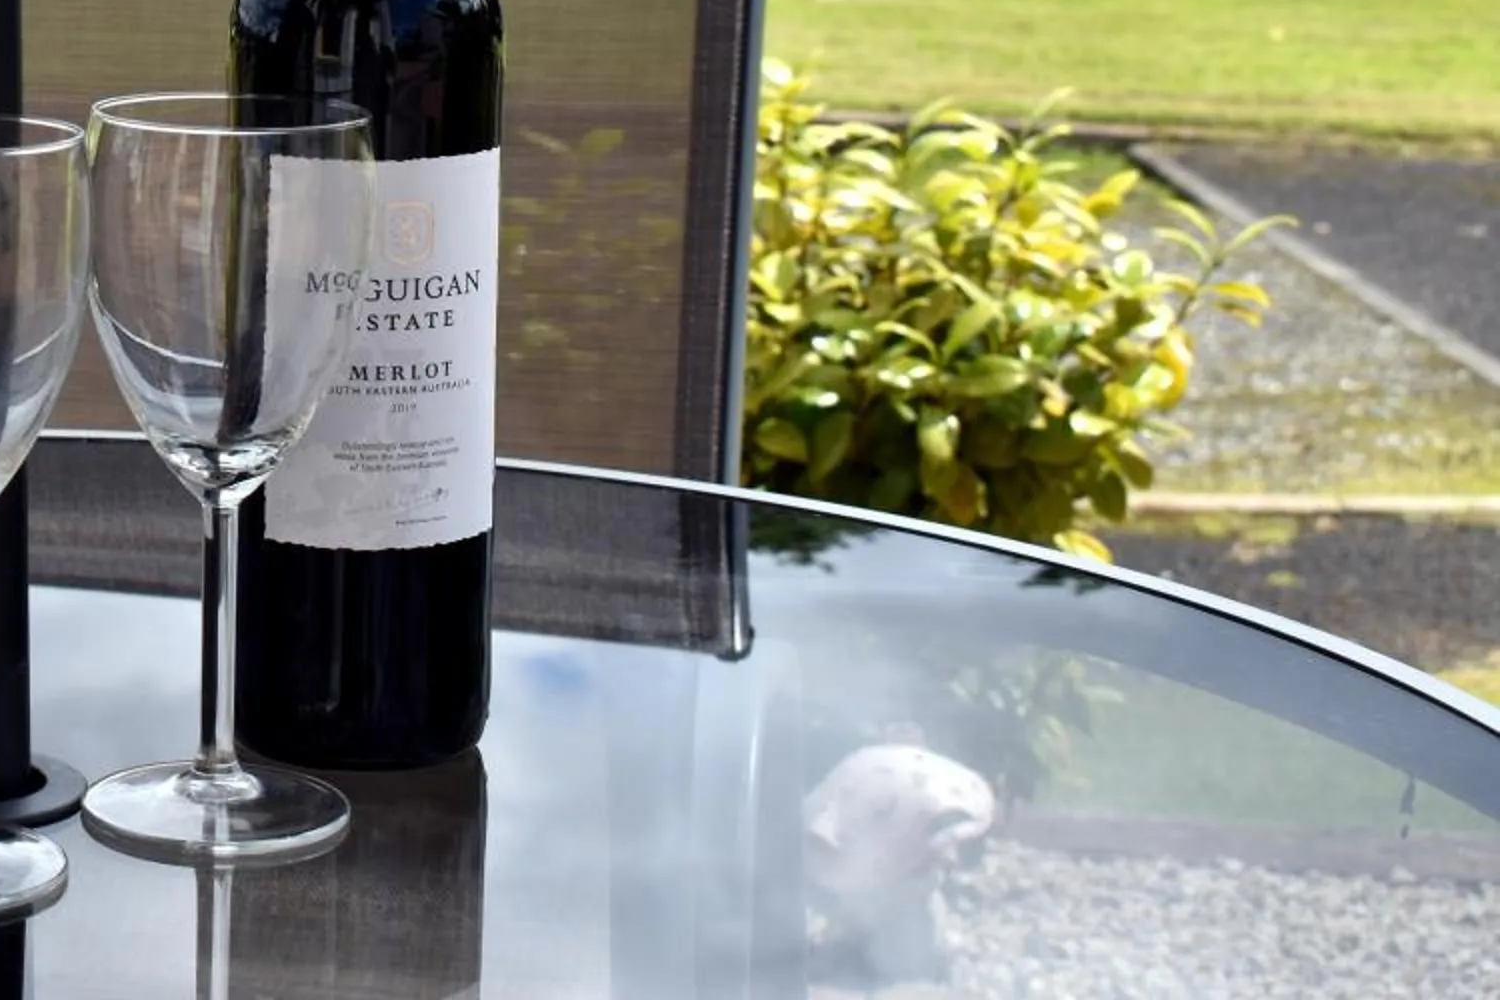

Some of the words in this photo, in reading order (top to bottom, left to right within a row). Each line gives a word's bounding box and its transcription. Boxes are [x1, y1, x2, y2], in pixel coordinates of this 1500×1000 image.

[355, 309, 455, 332] STATE
[348, 360, 454, 382] MERLOT
[328, 384, 361, 396] UTH
[365, 384, 418, 396] EASTERN
